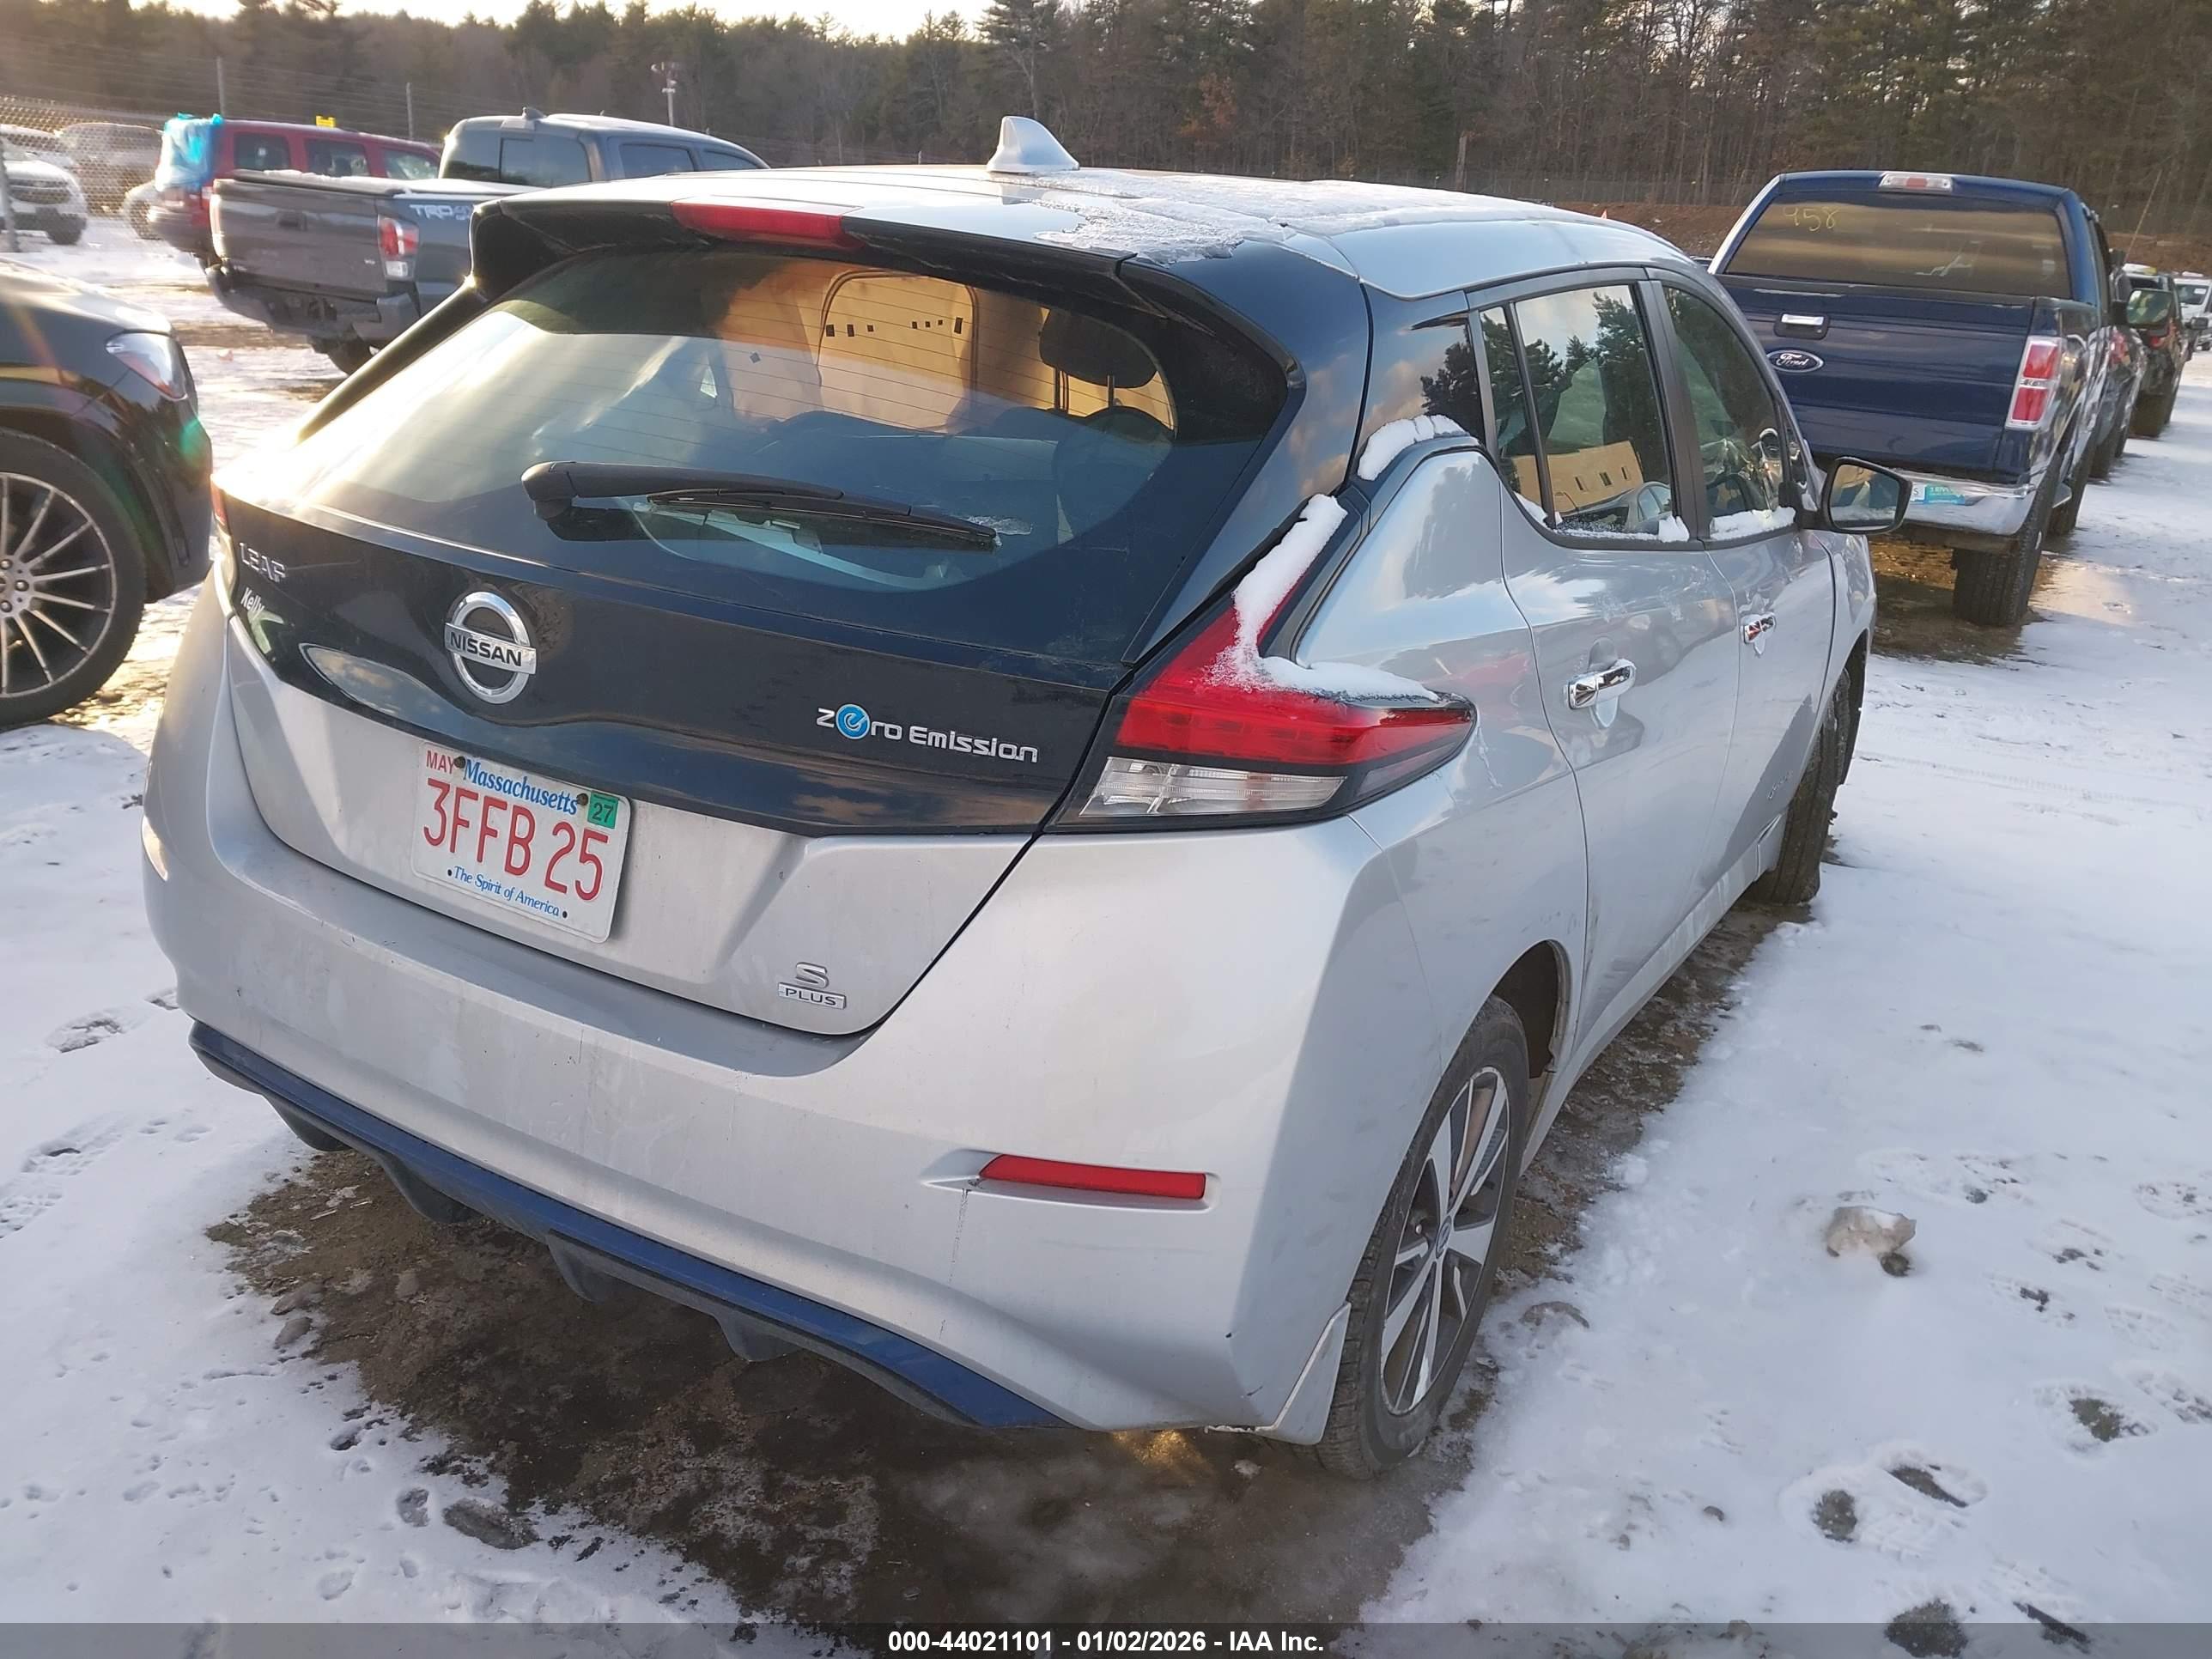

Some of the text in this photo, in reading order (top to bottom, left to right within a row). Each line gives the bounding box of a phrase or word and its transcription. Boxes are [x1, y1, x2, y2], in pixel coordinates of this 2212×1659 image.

[410, 204, 453, 219] TRD
[1776, 353, 1809, 367] Ford
[240, 542, 286, 582] LEAF
[240, 587, 265, 620] Kelly
[450, 631, 522, 667] NISSAN
[908, 726, 1038, 763] Emission
[426, 750, 455, 775] MAY
[463, 758, 579, 816] Massachusetts
[592, 802, 614, 823] 27
[422, 777, 609, 901] 3FFB 25
[454, 866, 560, 917] The Spirit of America
[796, 962, 829, 988] S
[785, 988, 836, 1006] PLUS
